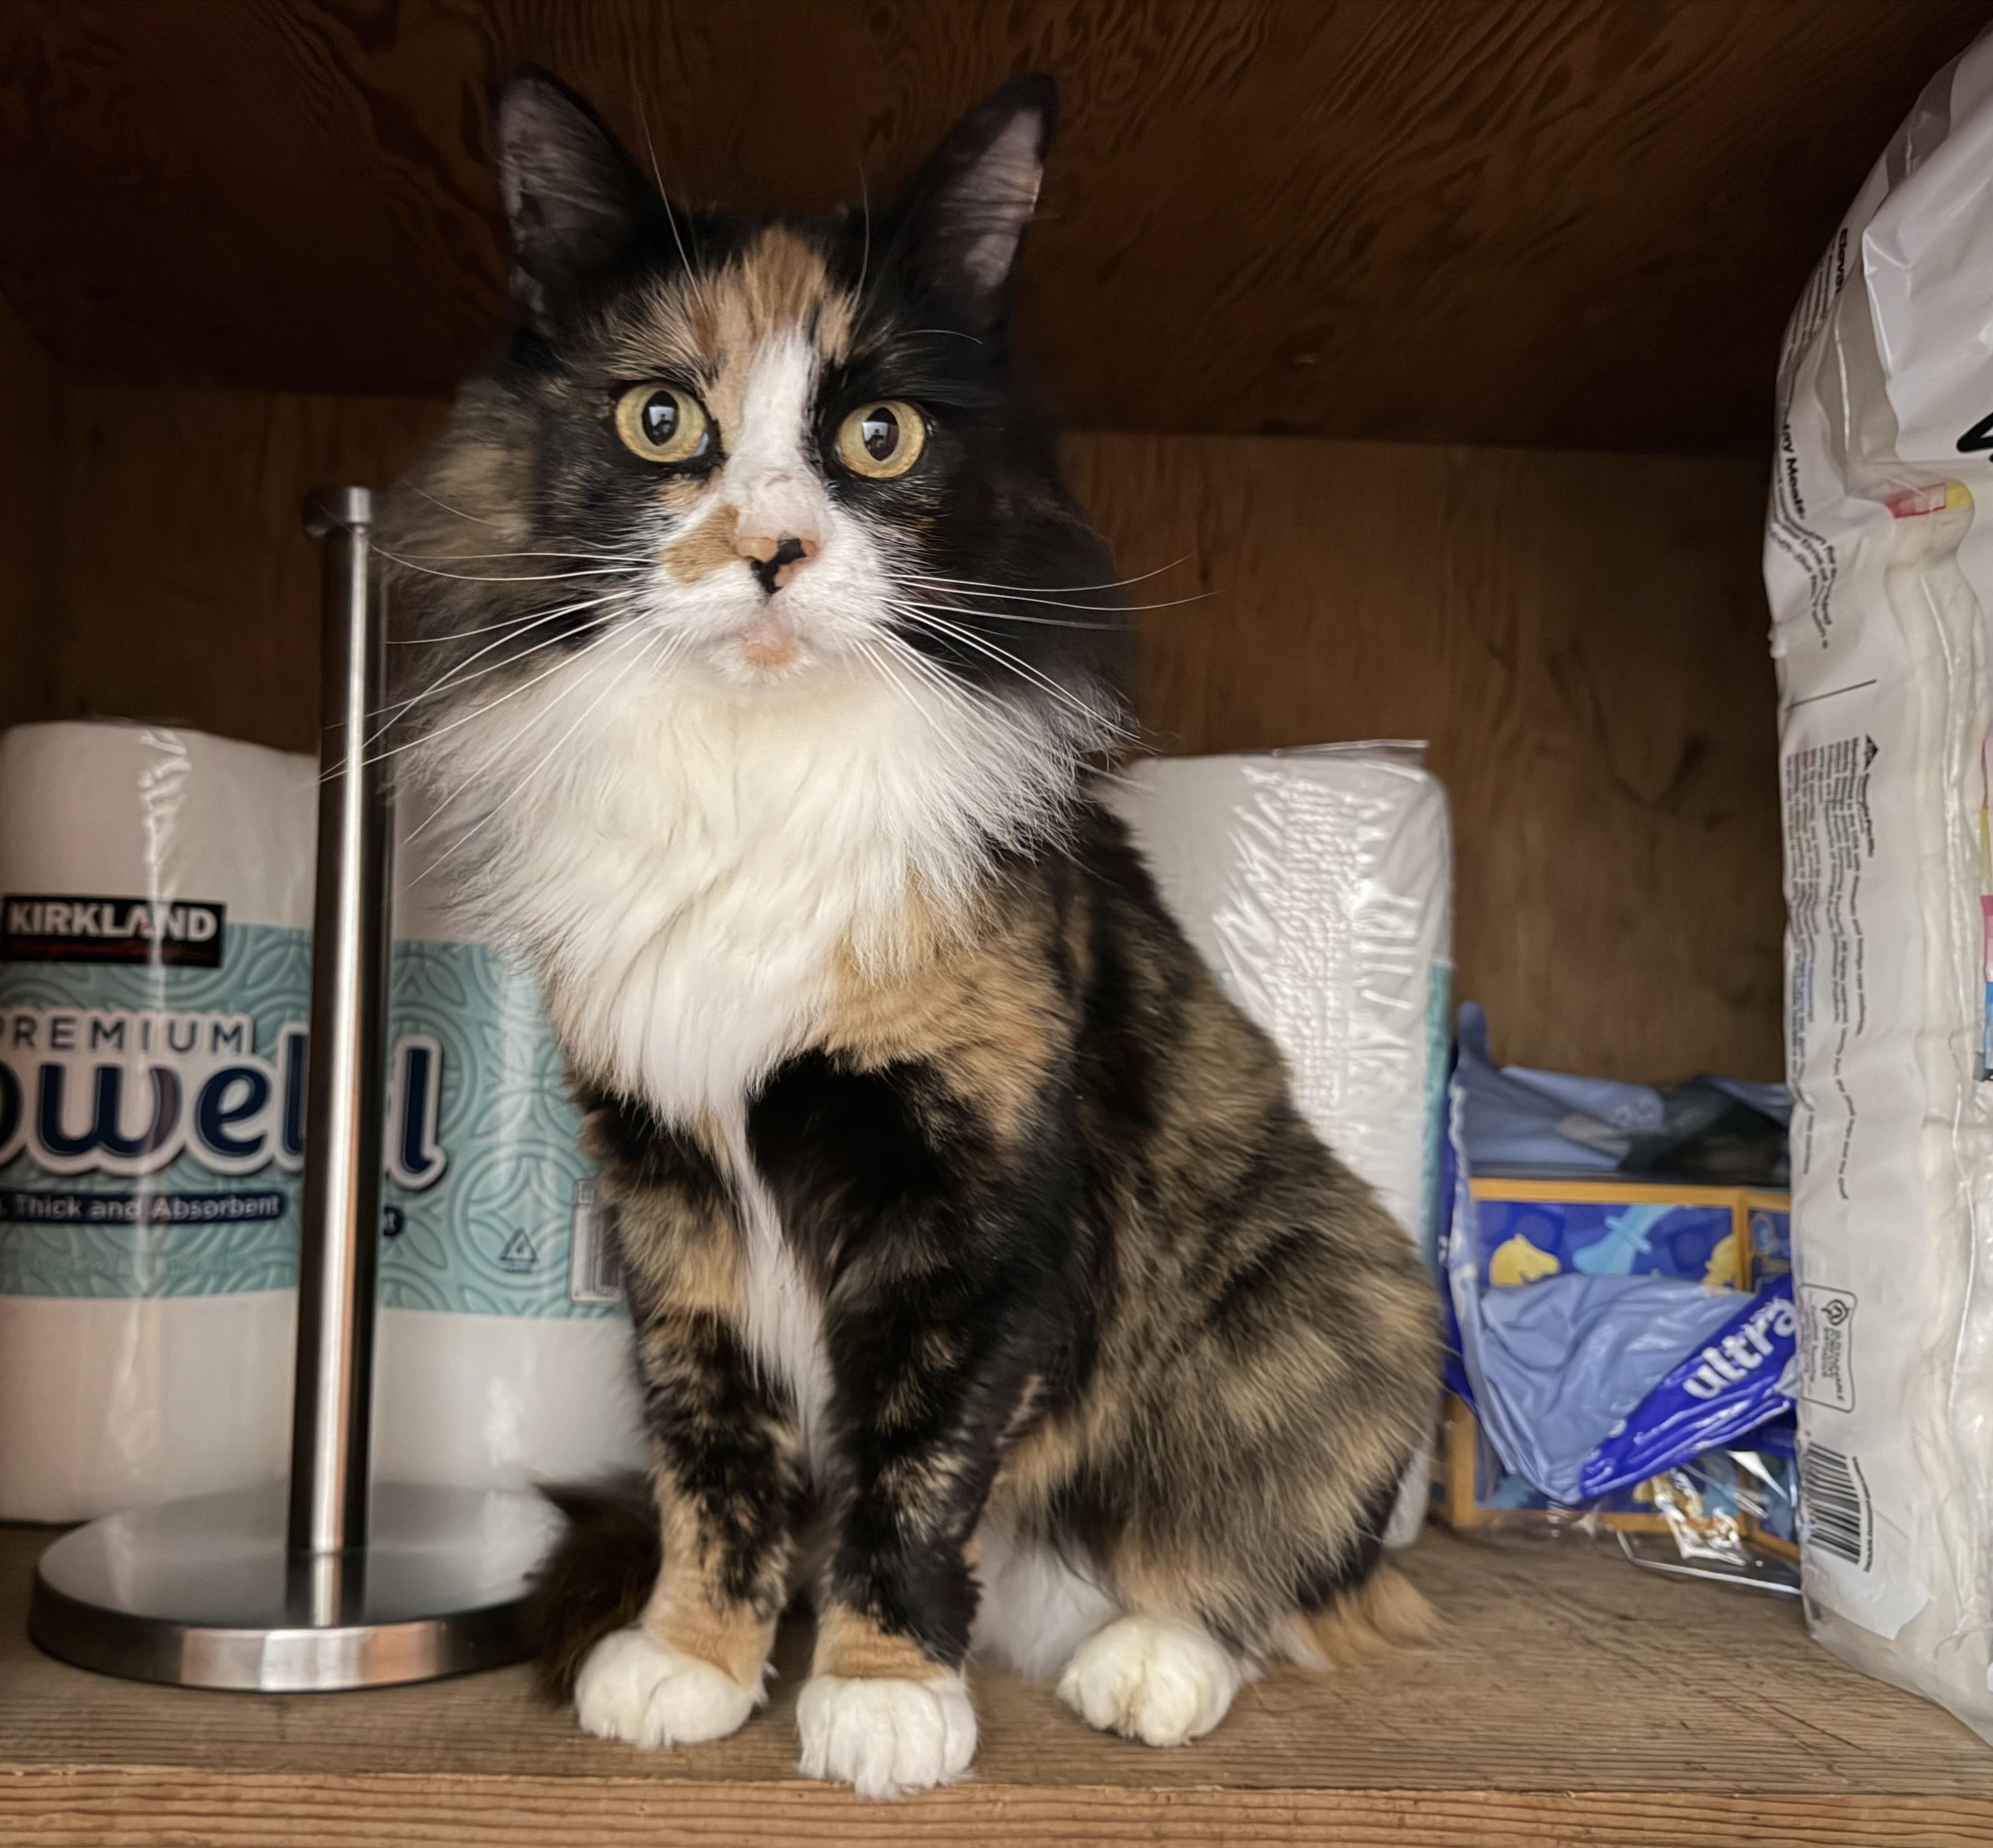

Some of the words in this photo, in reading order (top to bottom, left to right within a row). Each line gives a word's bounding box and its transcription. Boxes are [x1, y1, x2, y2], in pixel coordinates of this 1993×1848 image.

[9, 902, 218, 942] KIRKLAND
[0, 1015, 244, 1054] REMIUM
[16, 1193, 82, 1219] Thick
[88, 1197, 142, 1220] and
[151, 1193, 279, 1219] Absorbent
[1683, 1295, 1796, 1399] ultra
